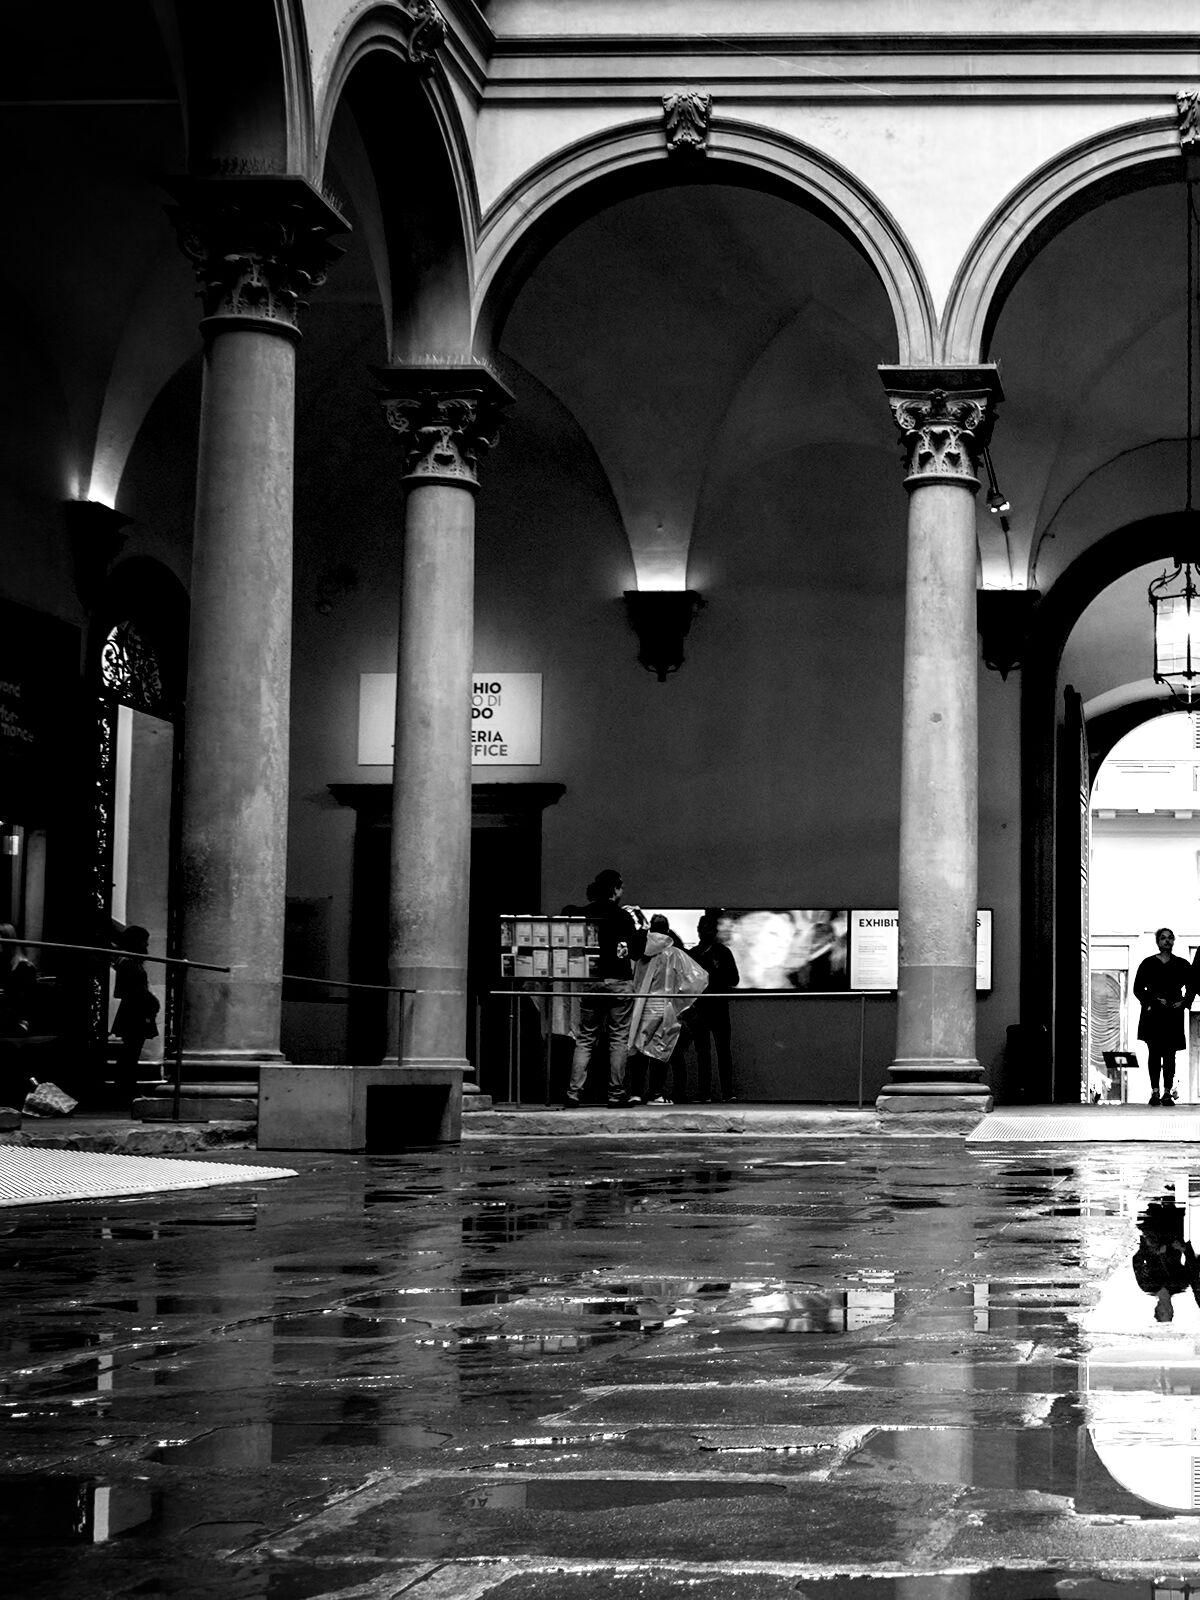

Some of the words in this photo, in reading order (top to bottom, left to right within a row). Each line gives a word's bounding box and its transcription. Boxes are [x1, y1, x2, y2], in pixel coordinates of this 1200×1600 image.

[473, 682, 501, 694] HIO
[472, 694, 483, 706] O
[488, 694, 501, 707] DI
[471, 707, 493, 719] DO
[471, 730, 503, 742] ERIA
[471, 744, 508, 756] FICE
[859, 918, 899, 928] EXHIBIT
